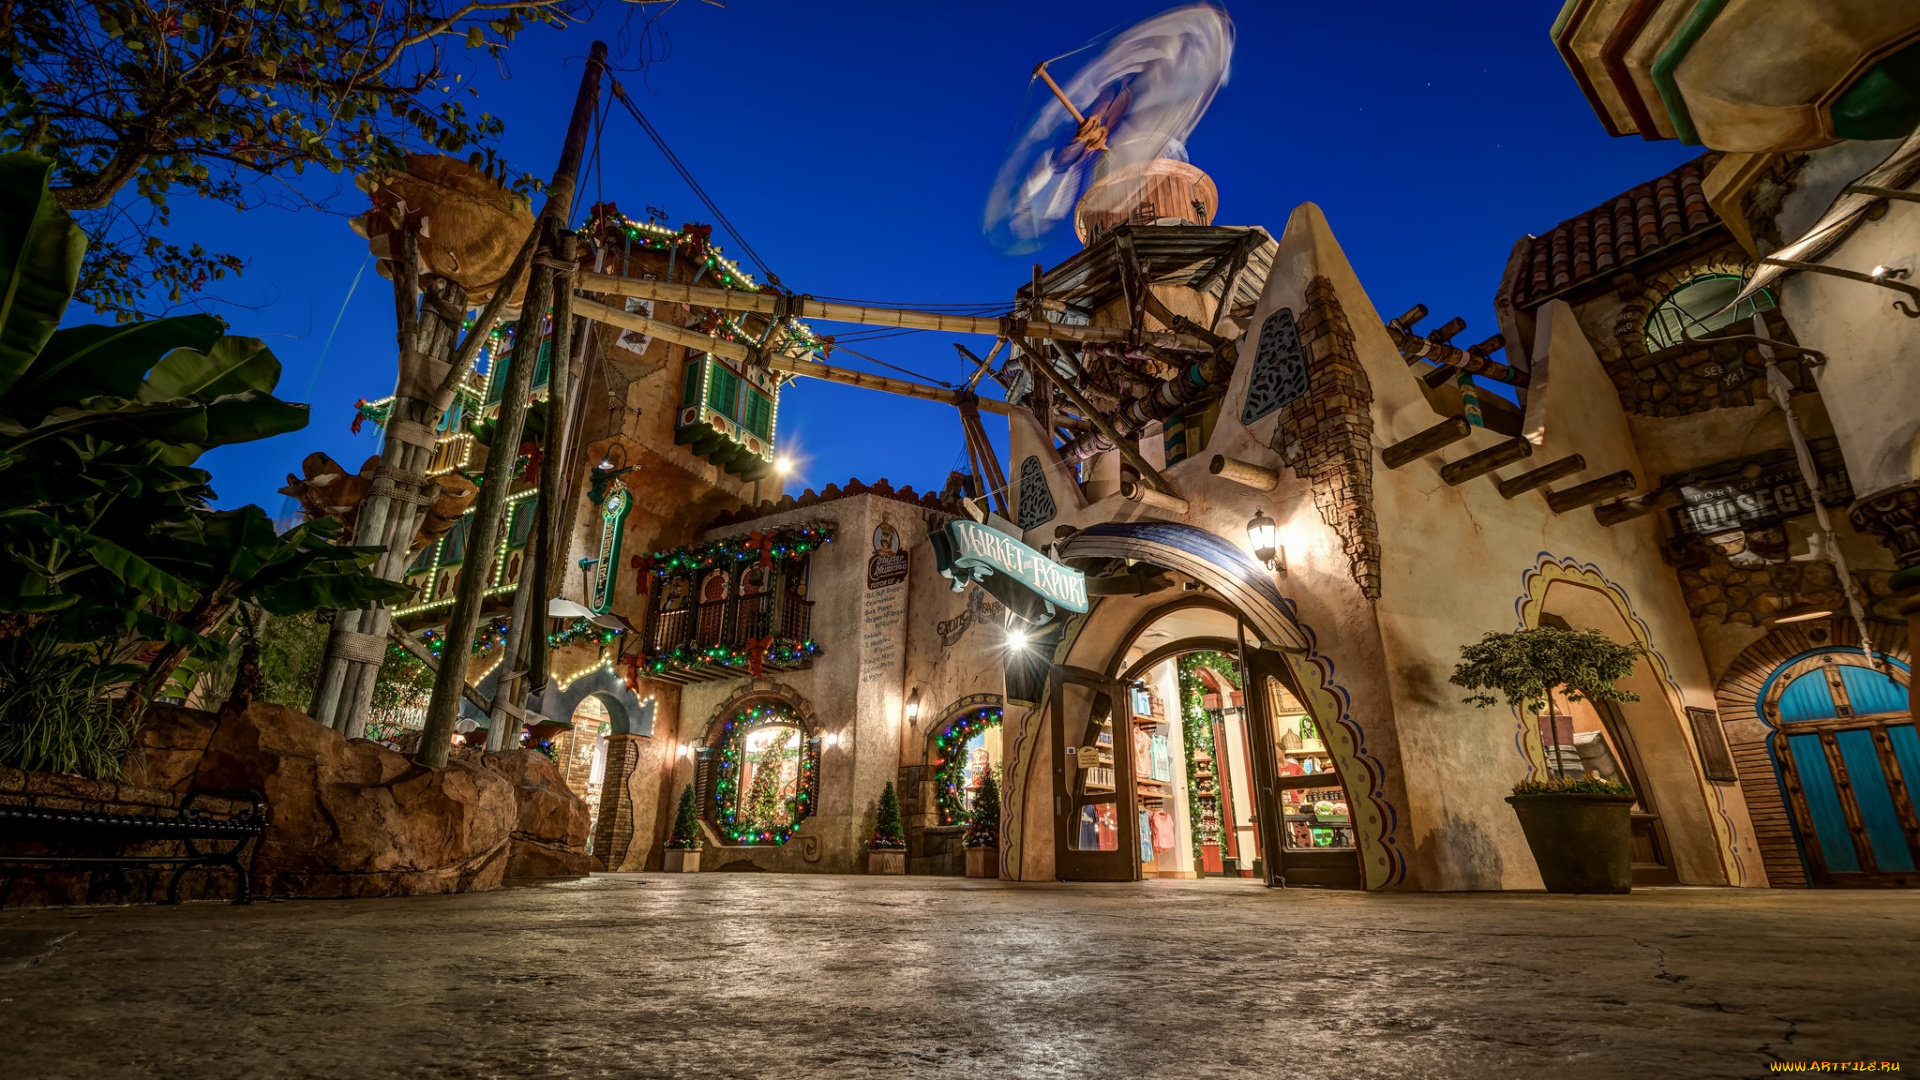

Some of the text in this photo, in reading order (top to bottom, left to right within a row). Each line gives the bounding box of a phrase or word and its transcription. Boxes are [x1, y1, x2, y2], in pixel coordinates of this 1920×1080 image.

[1703, 365, 1725, 377] SEE
[1723, 367, 1745, 386] YA!
[1694, 485, 1733, 502] PORT
[956, 523, 1025, 575] MARKET
[1031, 555, 1087, 607] EXPORT
[937, 610, 969, 636] EXOTIC
